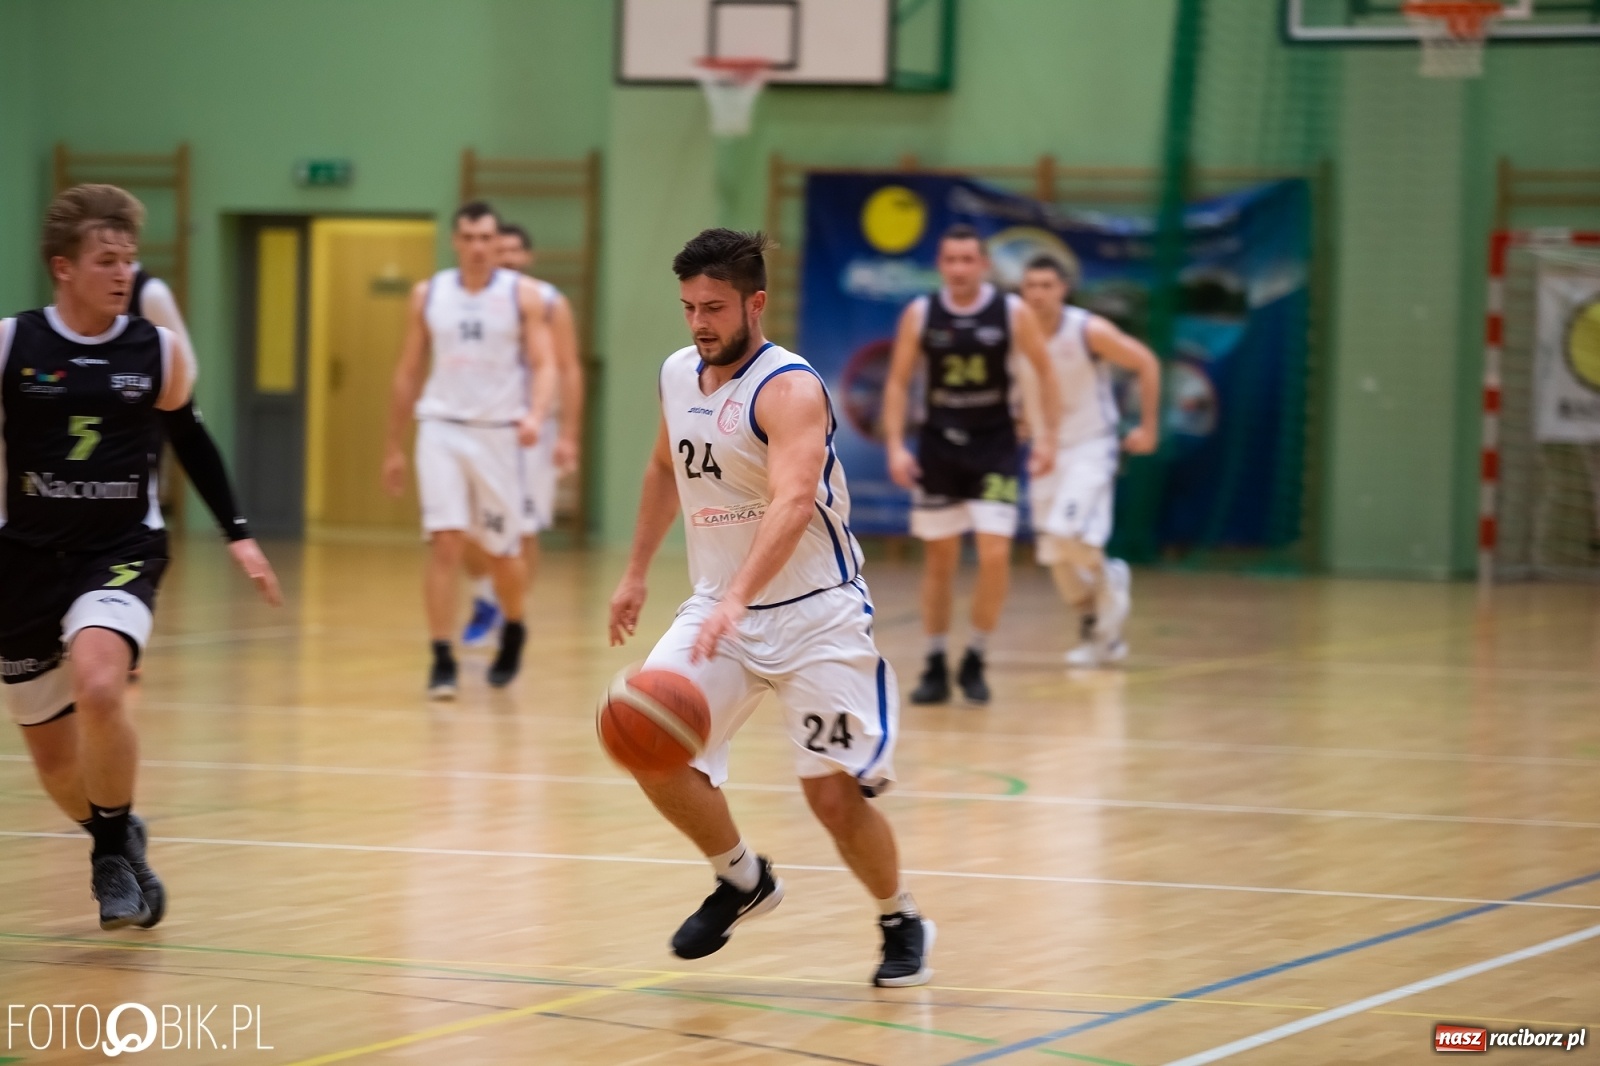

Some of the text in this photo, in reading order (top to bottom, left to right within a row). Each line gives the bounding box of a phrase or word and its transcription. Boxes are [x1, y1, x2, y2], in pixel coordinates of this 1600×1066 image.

[941, 354, 988, 386] 24
[65, 415, 103, 461] 5
[678, 438, 722, 480] 24
[22, 470, 140, 499] Nacomi
[703, 509, 757, 524] KAMPKA
[102, 560, 145, 587] 5
[802, 712, 855, 753] 24
